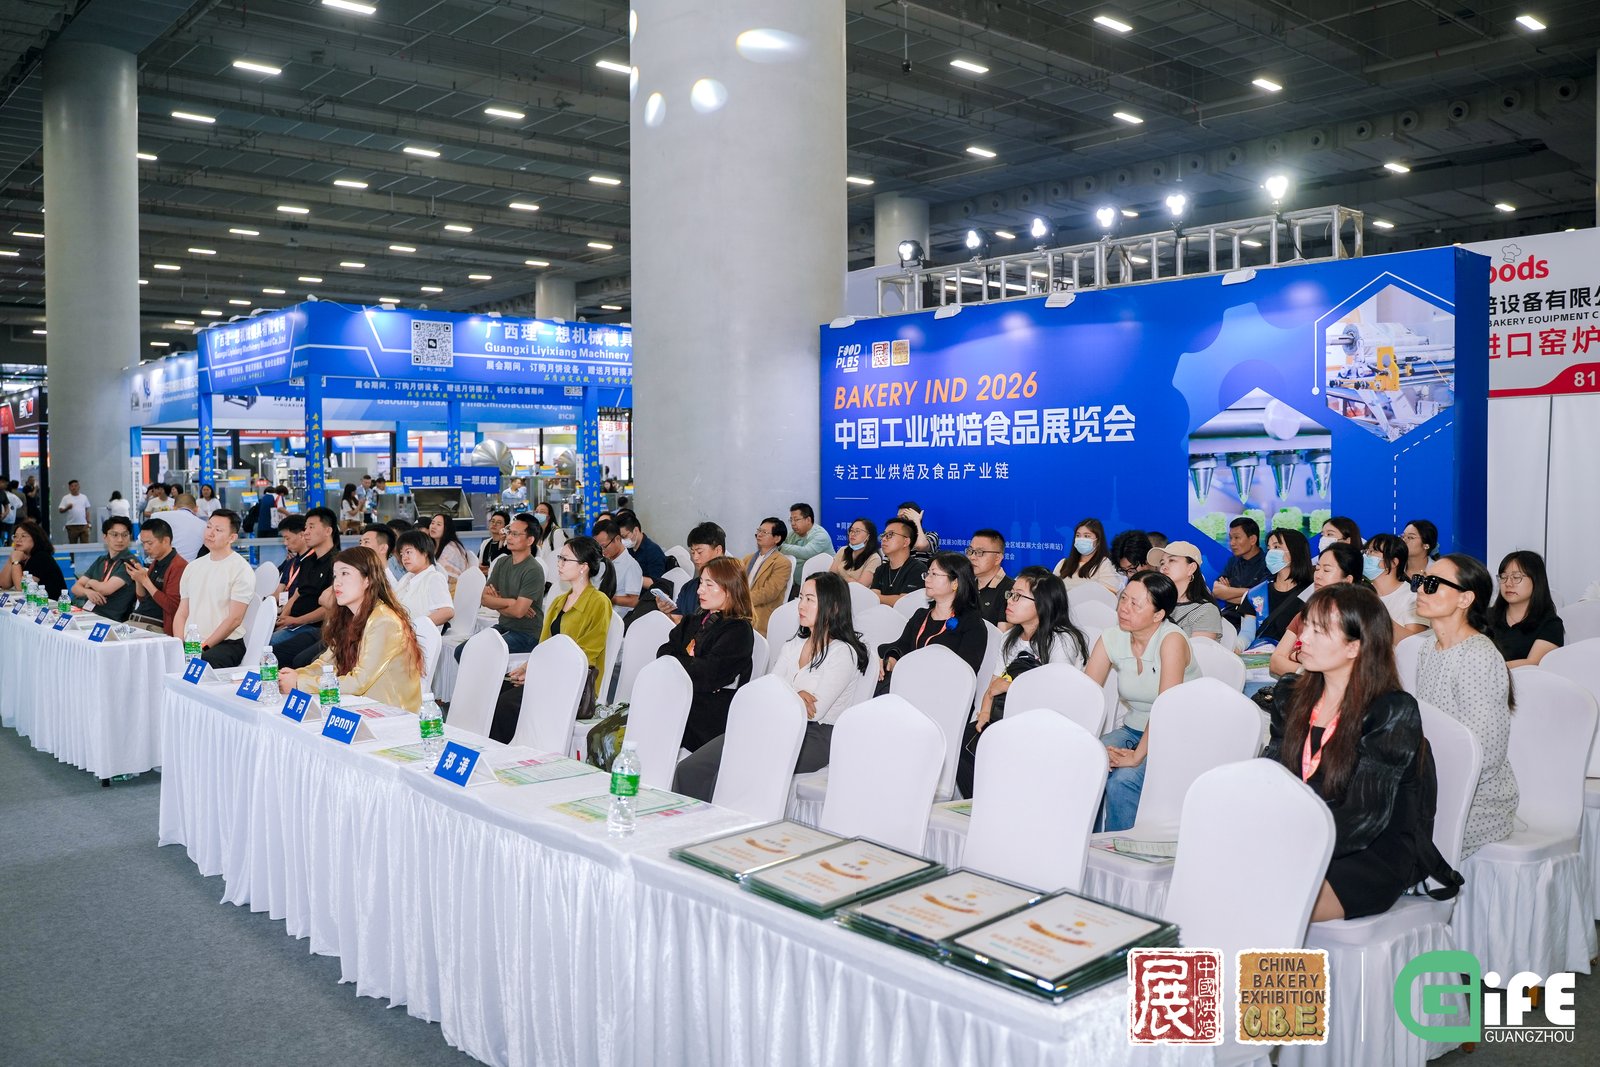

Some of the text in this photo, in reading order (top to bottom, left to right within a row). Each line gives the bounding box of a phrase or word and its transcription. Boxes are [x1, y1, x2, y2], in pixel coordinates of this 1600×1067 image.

[1489, 286, 1600, 315] 设备有限
[1528, 311, 1590, 325] EQUIPMENT
[484, 342, 630, 362] Guangxi Liyixiang Machinery
[1574, 370, 1596, 387] 81
[833, 371, 1039, 410] BAKERY IND 2026
[834, 404, 1136, 450] 中国工业烘焙食品展览会
[834, 461, 1009, 480] 专注工业烘焙及食品产业链
[327, 714, 355, 734] penny
